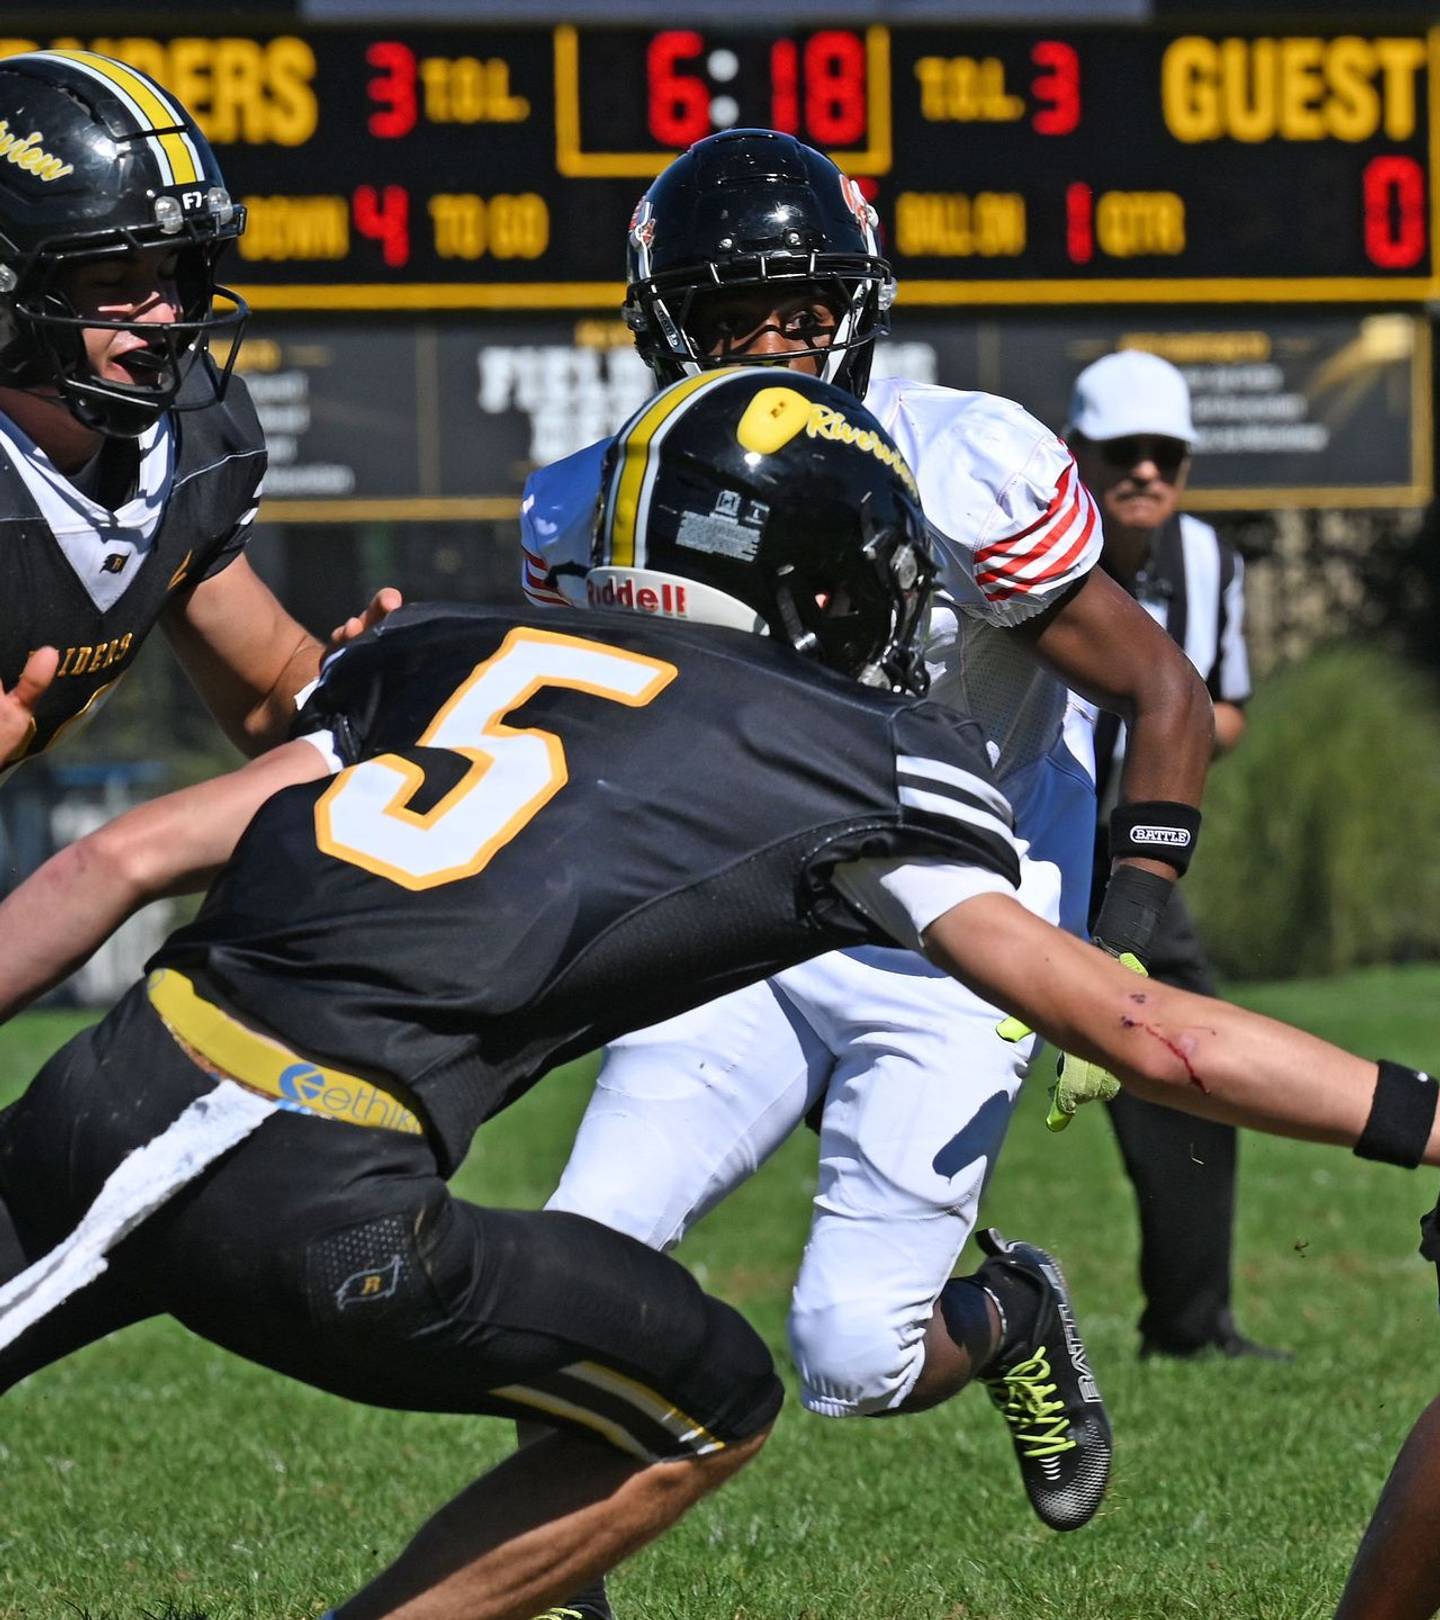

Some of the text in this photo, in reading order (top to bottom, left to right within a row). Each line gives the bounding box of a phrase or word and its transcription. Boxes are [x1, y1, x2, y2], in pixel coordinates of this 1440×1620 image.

[366, 41, 417, 138] 3
[647, 30, 865, 147] 6:18
[1030, 40, 1081, 136] 3
[1161, 36, 1430, 143] GUEST
[182, 191, 203, 210] F7
[353, 184, 409, 268] 4
[1066, 181, 1093, 265] 1
[1363, 155, 1425, 270] 0
[315, 626, 679, 891] 5
[1134, 829, 1187, 843] BATTLE
